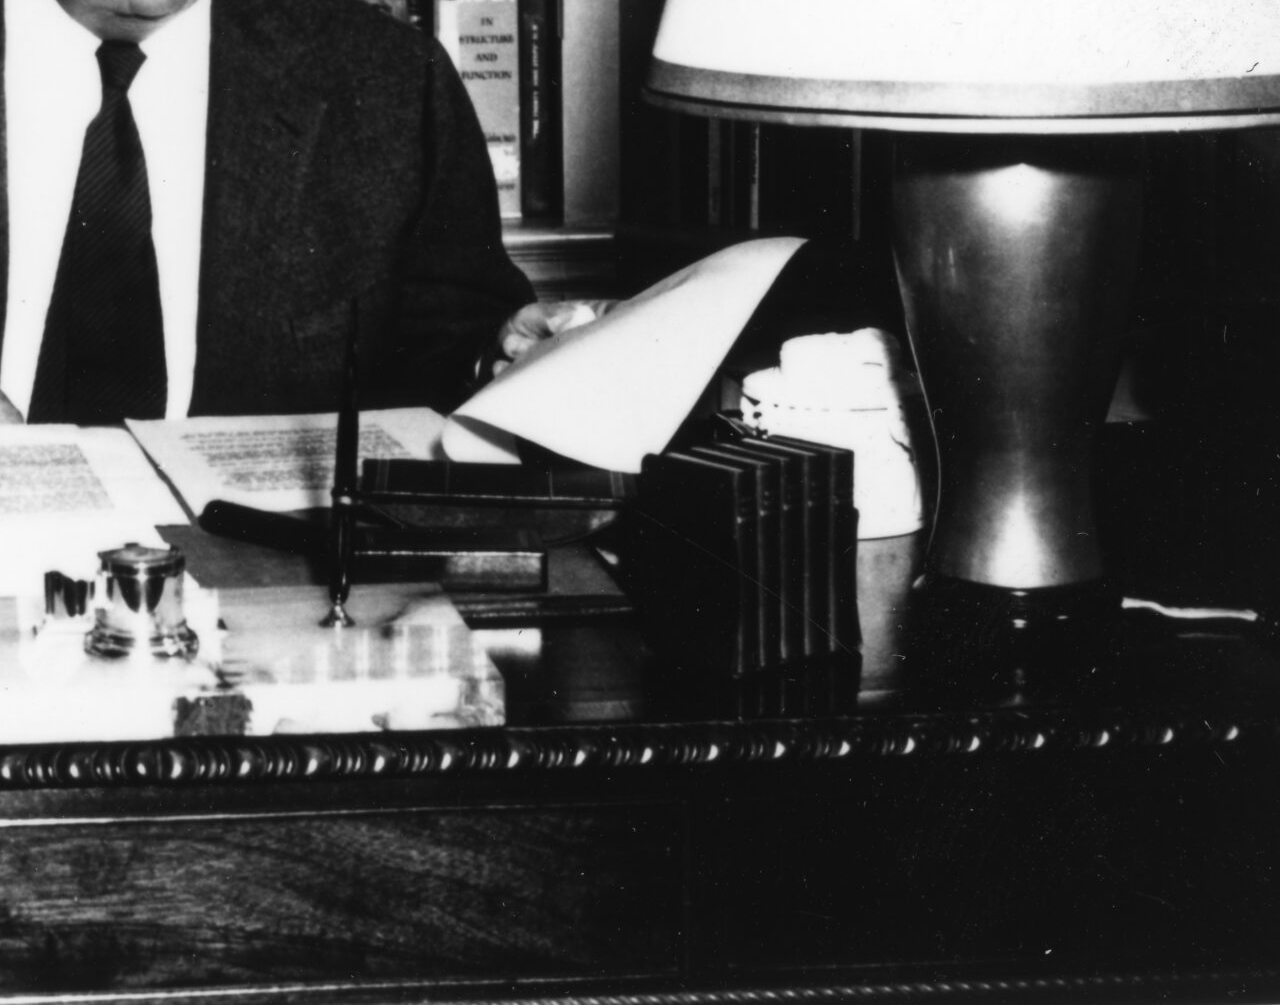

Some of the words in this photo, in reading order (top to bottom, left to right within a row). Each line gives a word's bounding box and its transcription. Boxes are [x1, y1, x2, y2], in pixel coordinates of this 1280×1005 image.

[480, 17, 494, 26] IN
[459, 34, 515, 45] STRUCTURE
[475, 52, 499, 62] AND
[461, 70, 513, 81] FUNCTION
